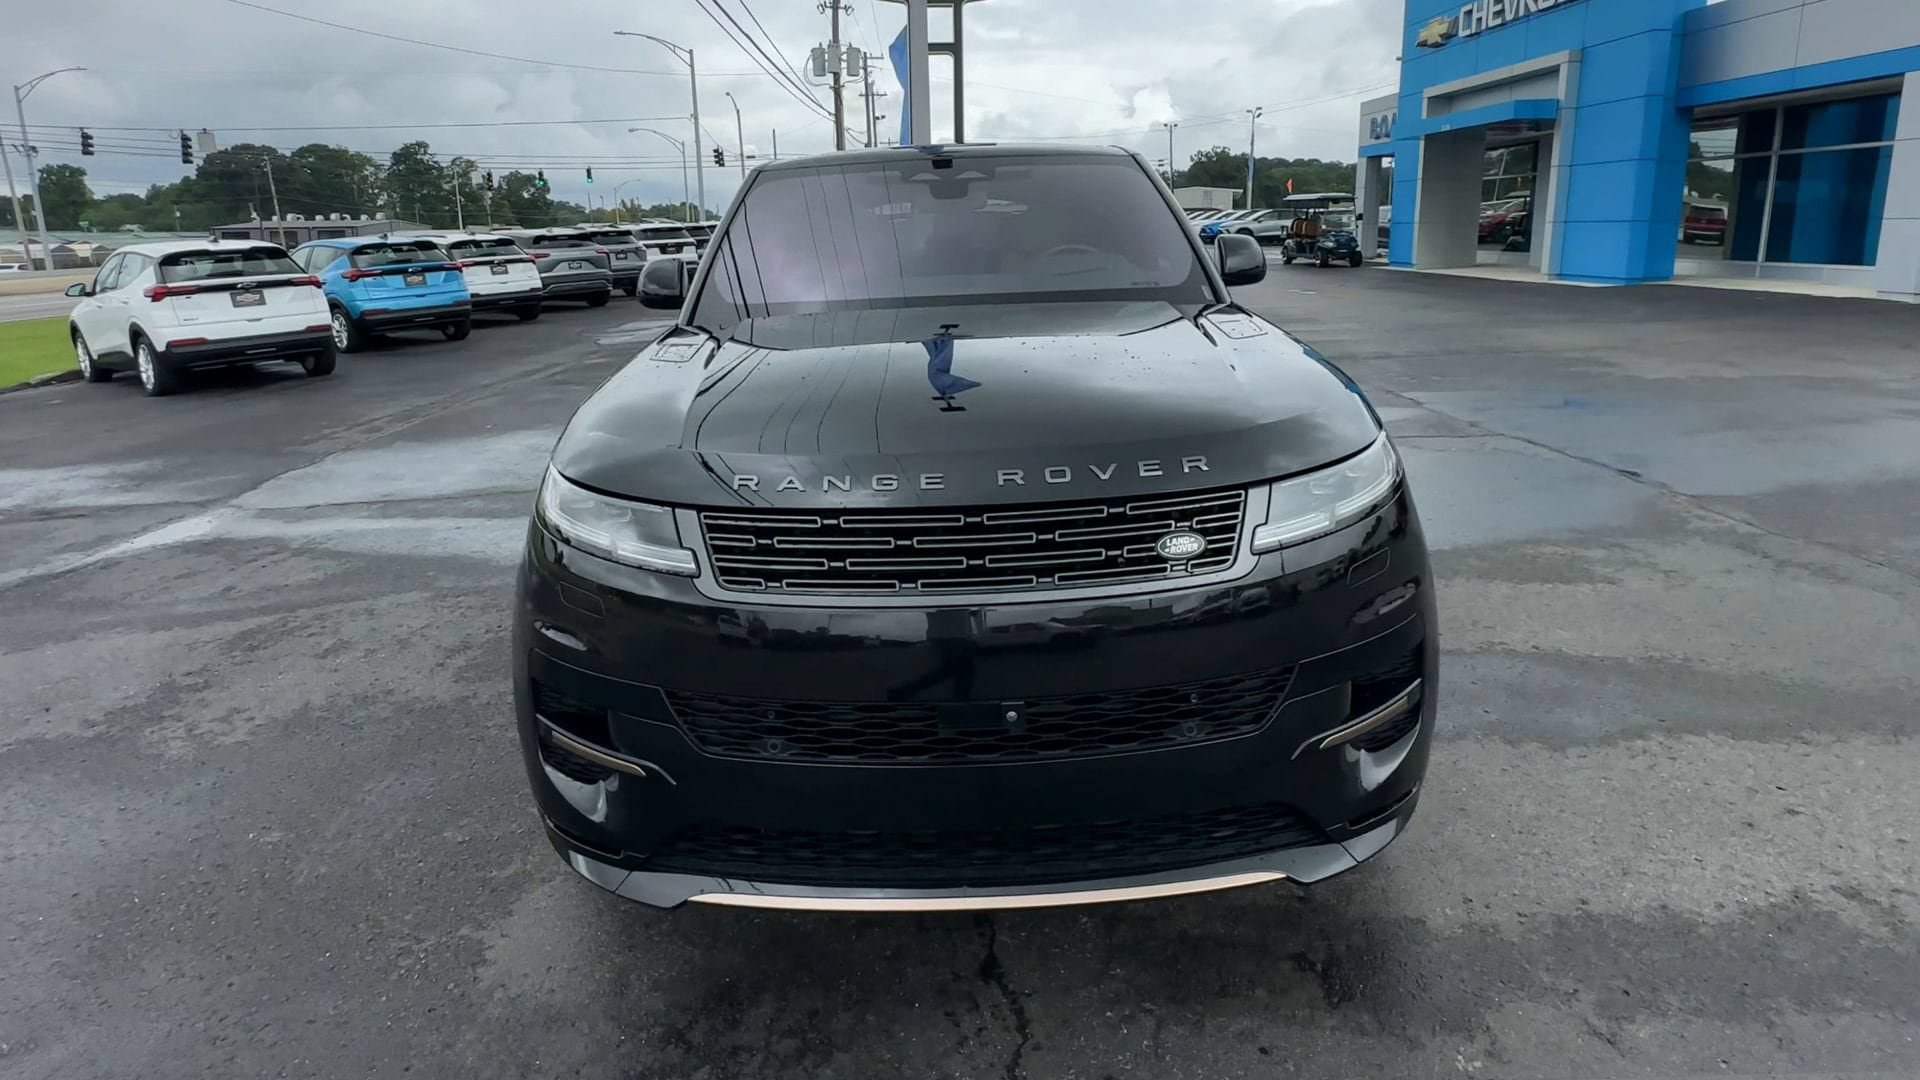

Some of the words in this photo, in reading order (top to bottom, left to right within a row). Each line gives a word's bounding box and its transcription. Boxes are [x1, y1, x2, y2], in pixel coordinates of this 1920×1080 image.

[1458, 0, 1566, 38] CHEV
[732, 473, 946, 493] RANGE
[997, 455, 1211, 486] ROVER
[1170, 543, 1199, 554] ROVER
